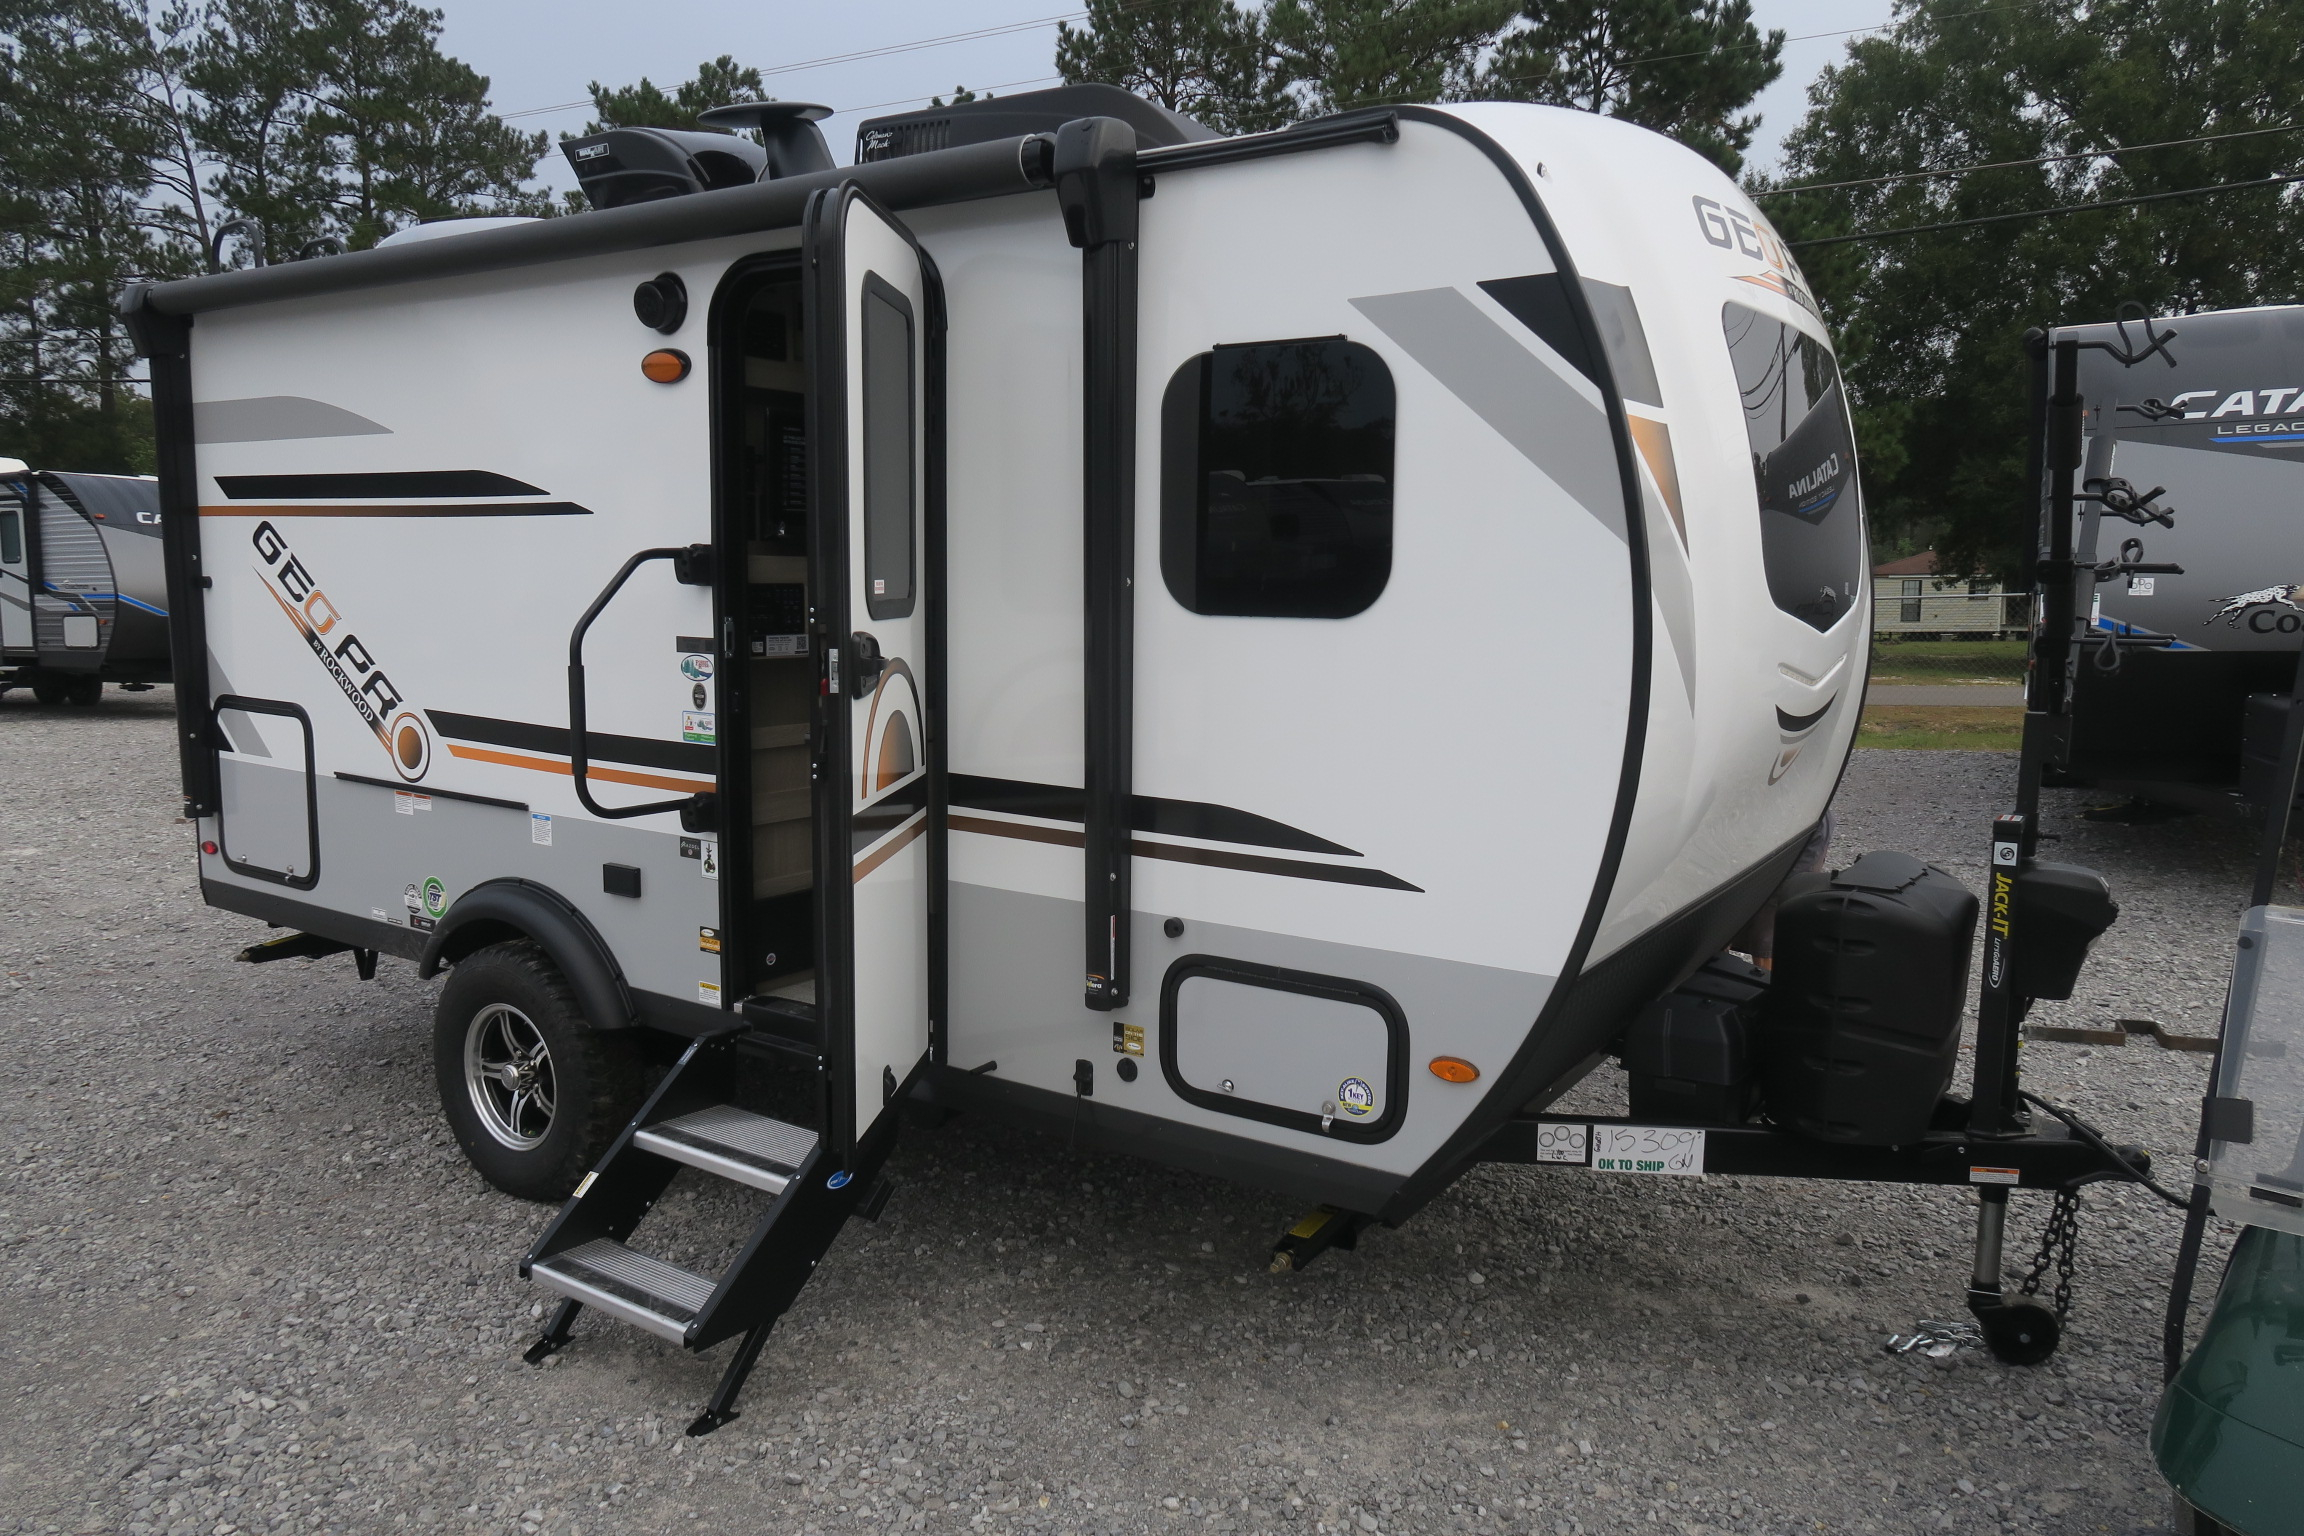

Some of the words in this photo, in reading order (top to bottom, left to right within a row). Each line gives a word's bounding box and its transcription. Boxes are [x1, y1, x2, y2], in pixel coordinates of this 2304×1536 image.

[1692, 195, 1784, 272] GEO
[252, 520, 342, 635] GEO
[2249, 609, 2304, 634] Co
[320, 648, 374, 722] ROCKWOOD
[1992, 872, 2013, 937] JACK-IT
[1598, 1158, 1615, 1170] OK
[1618, 1158, 1633, 1171] TO
[1636, 1160, 1665, 1172] SHIP
